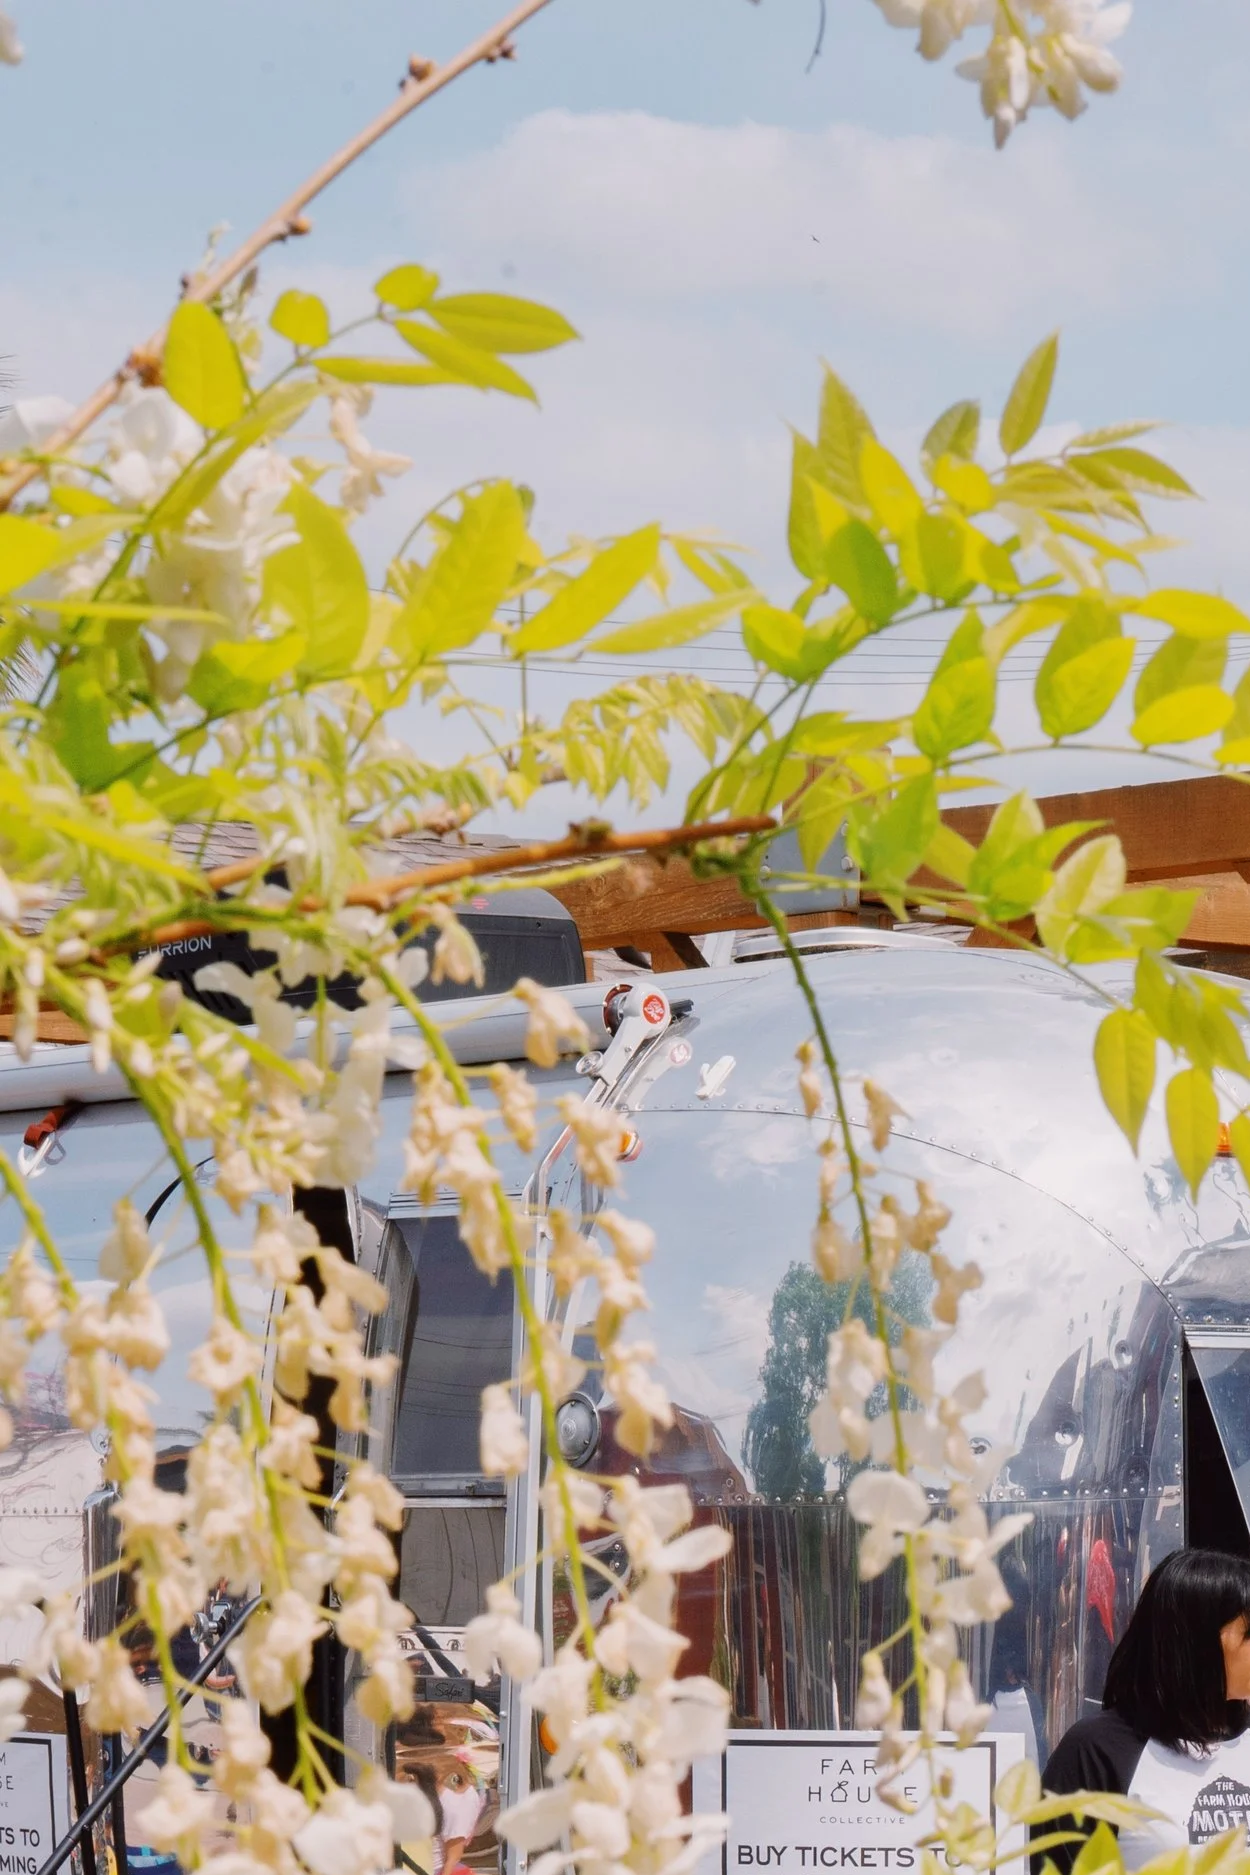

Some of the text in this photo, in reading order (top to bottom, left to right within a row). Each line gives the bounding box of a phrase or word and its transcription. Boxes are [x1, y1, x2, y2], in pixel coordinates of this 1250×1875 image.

[821, 1758, 888, 1775] FAR
[808, 1782, 918, 1803] HOUE
[1216, 1781, 1235, 1791] THE
[1197, 1793, 1226, 1807] FARM
[819, 1816, 905, 1824] COLLECTIVE
[20, 1828, 40, 1847] TO
[737, 1844, 788, 1866] BUY
[795, 1845, 915, 1868] TICKETS
